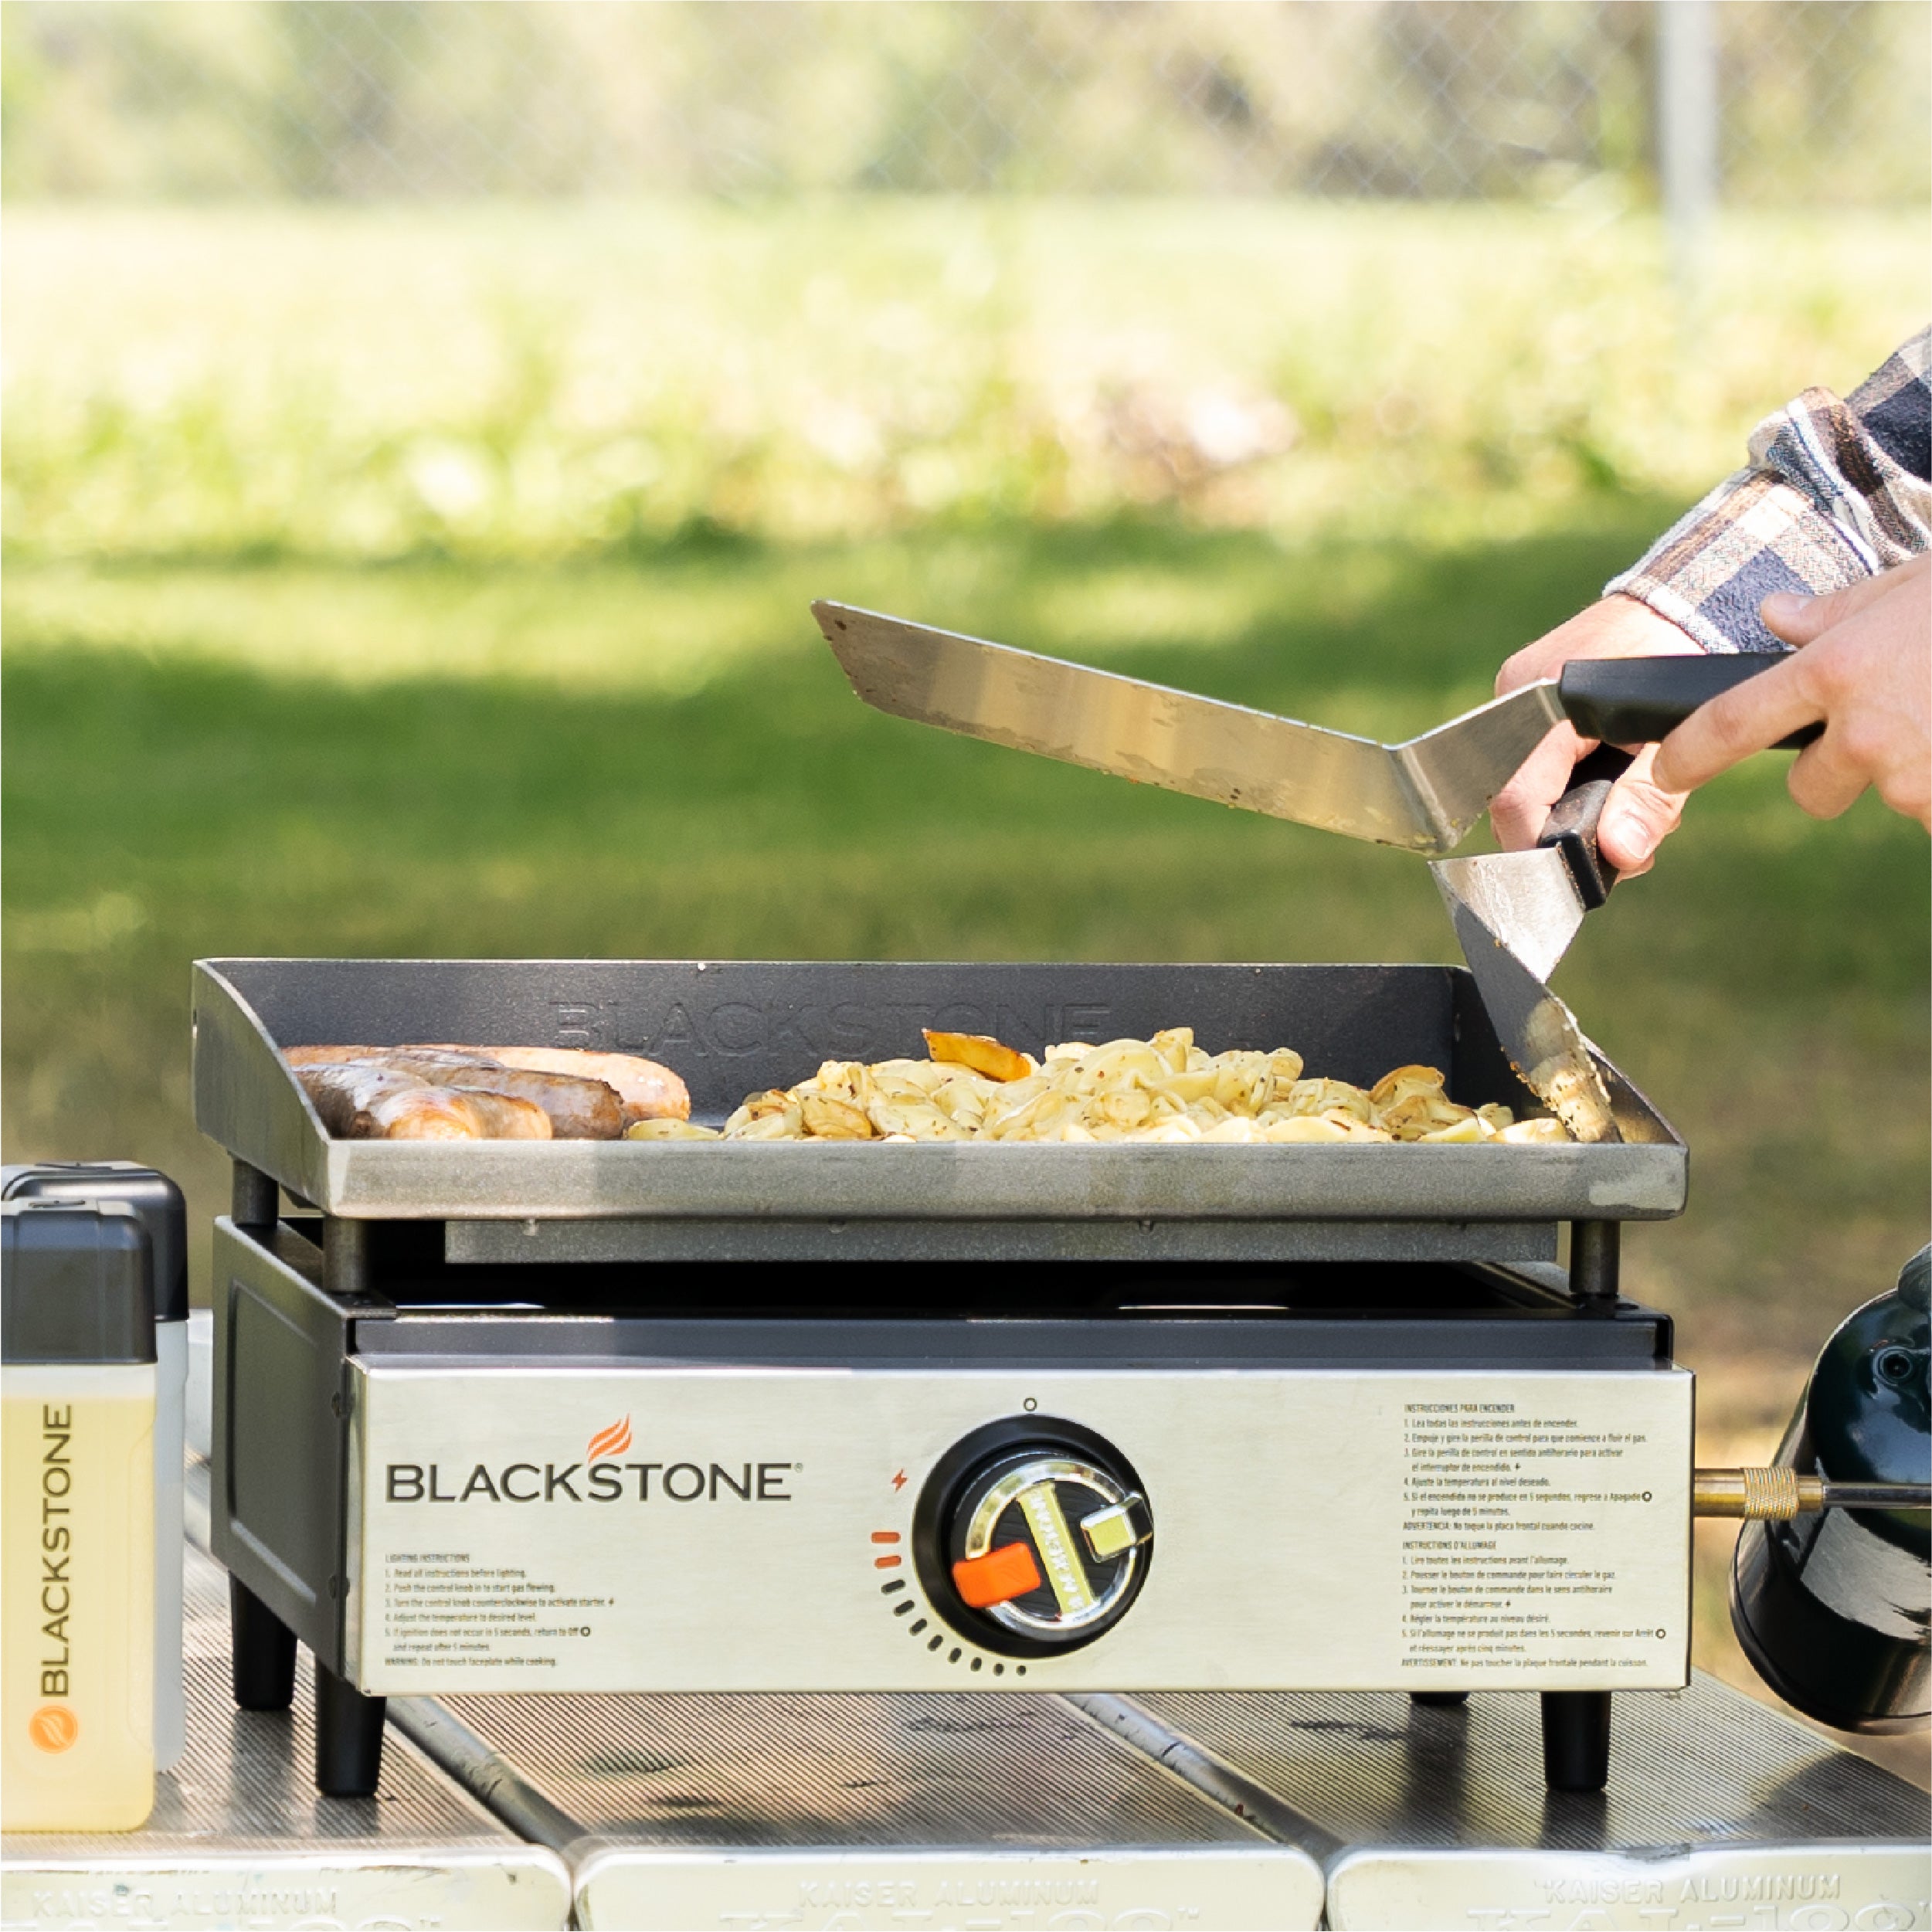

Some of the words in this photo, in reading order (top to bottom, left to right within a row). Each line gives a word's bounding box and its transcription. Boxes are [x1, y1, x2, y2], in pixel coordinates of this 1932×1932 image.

[548, 1001, 1112, 1058] BLACKSTONE
[385, 1462, 792, 1502] BLACKSTONE
[41, 1404, 73, 1698] BLACKSTONE
[32, 1890, 154, 1917] KAISER
[170, 1887, 338, 1917] ALUMINUM
[798, 1880, 919, 1908] KAISER
[934, 1878, 1100, 1908] ALUMINUM
[1545, 1878, 1664, 1904] KAISER
[1680, 1874, 1842, 1903] ALUMINUM
